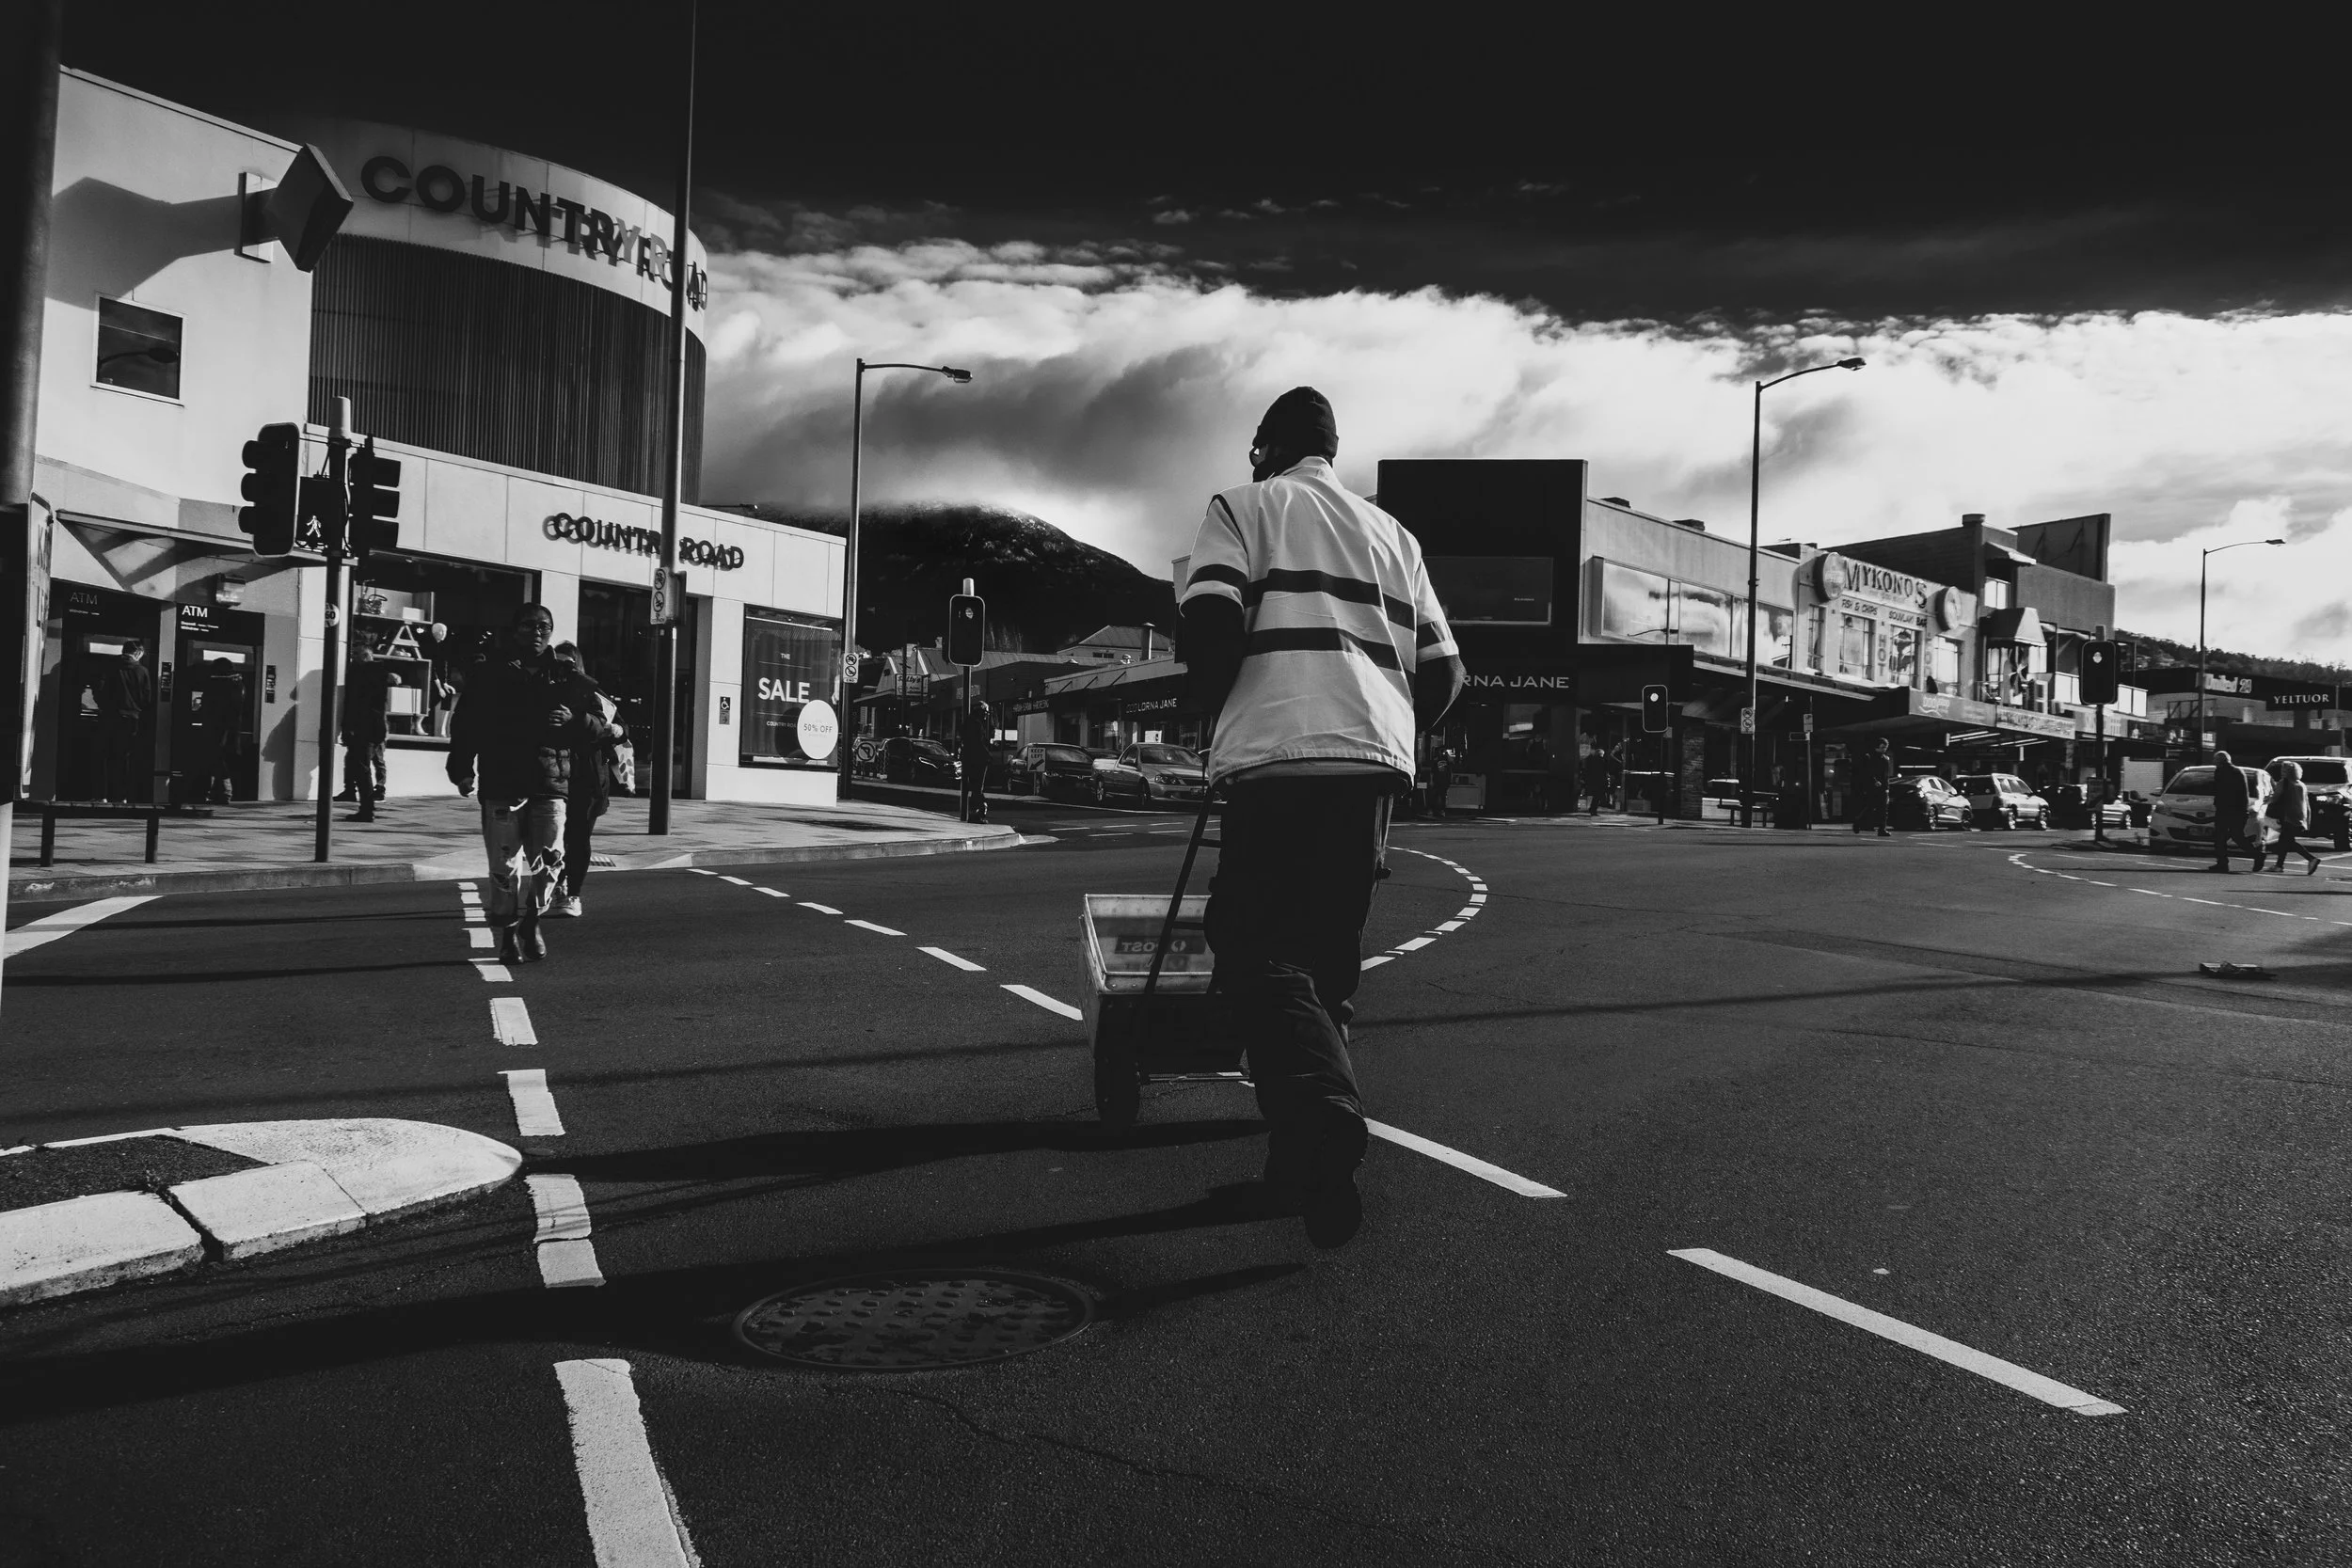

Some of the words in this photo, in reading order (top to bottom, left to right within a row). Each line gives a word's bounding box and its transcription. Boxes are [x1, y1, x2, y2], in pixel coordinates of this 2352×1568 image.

[361, 155, 642, 266] COUNTRY
[552, 513, 661, 556] COUNTR
[681, 536, 744, 569] ROAD
[1843, 560, 1927, 609] MYKONOS
[70, 592, 98, 605] ATM
[182, 605, 208, 617] ATM
[1878, 634, 1886, 676] HOT
[1462, 675, 1504, 688] RNA
[1510, 675, 1569, 689] JANE
[758, 676, 810, 704] SALE
[1138, 702, 1159, 712] LORNA
[1160, 698, 1177, 709] JANE
[2273, 693, 2329, 705] YELTUOR
[803, 723, 818, 733] 50%
[819, 725, 834, 734] OFF
